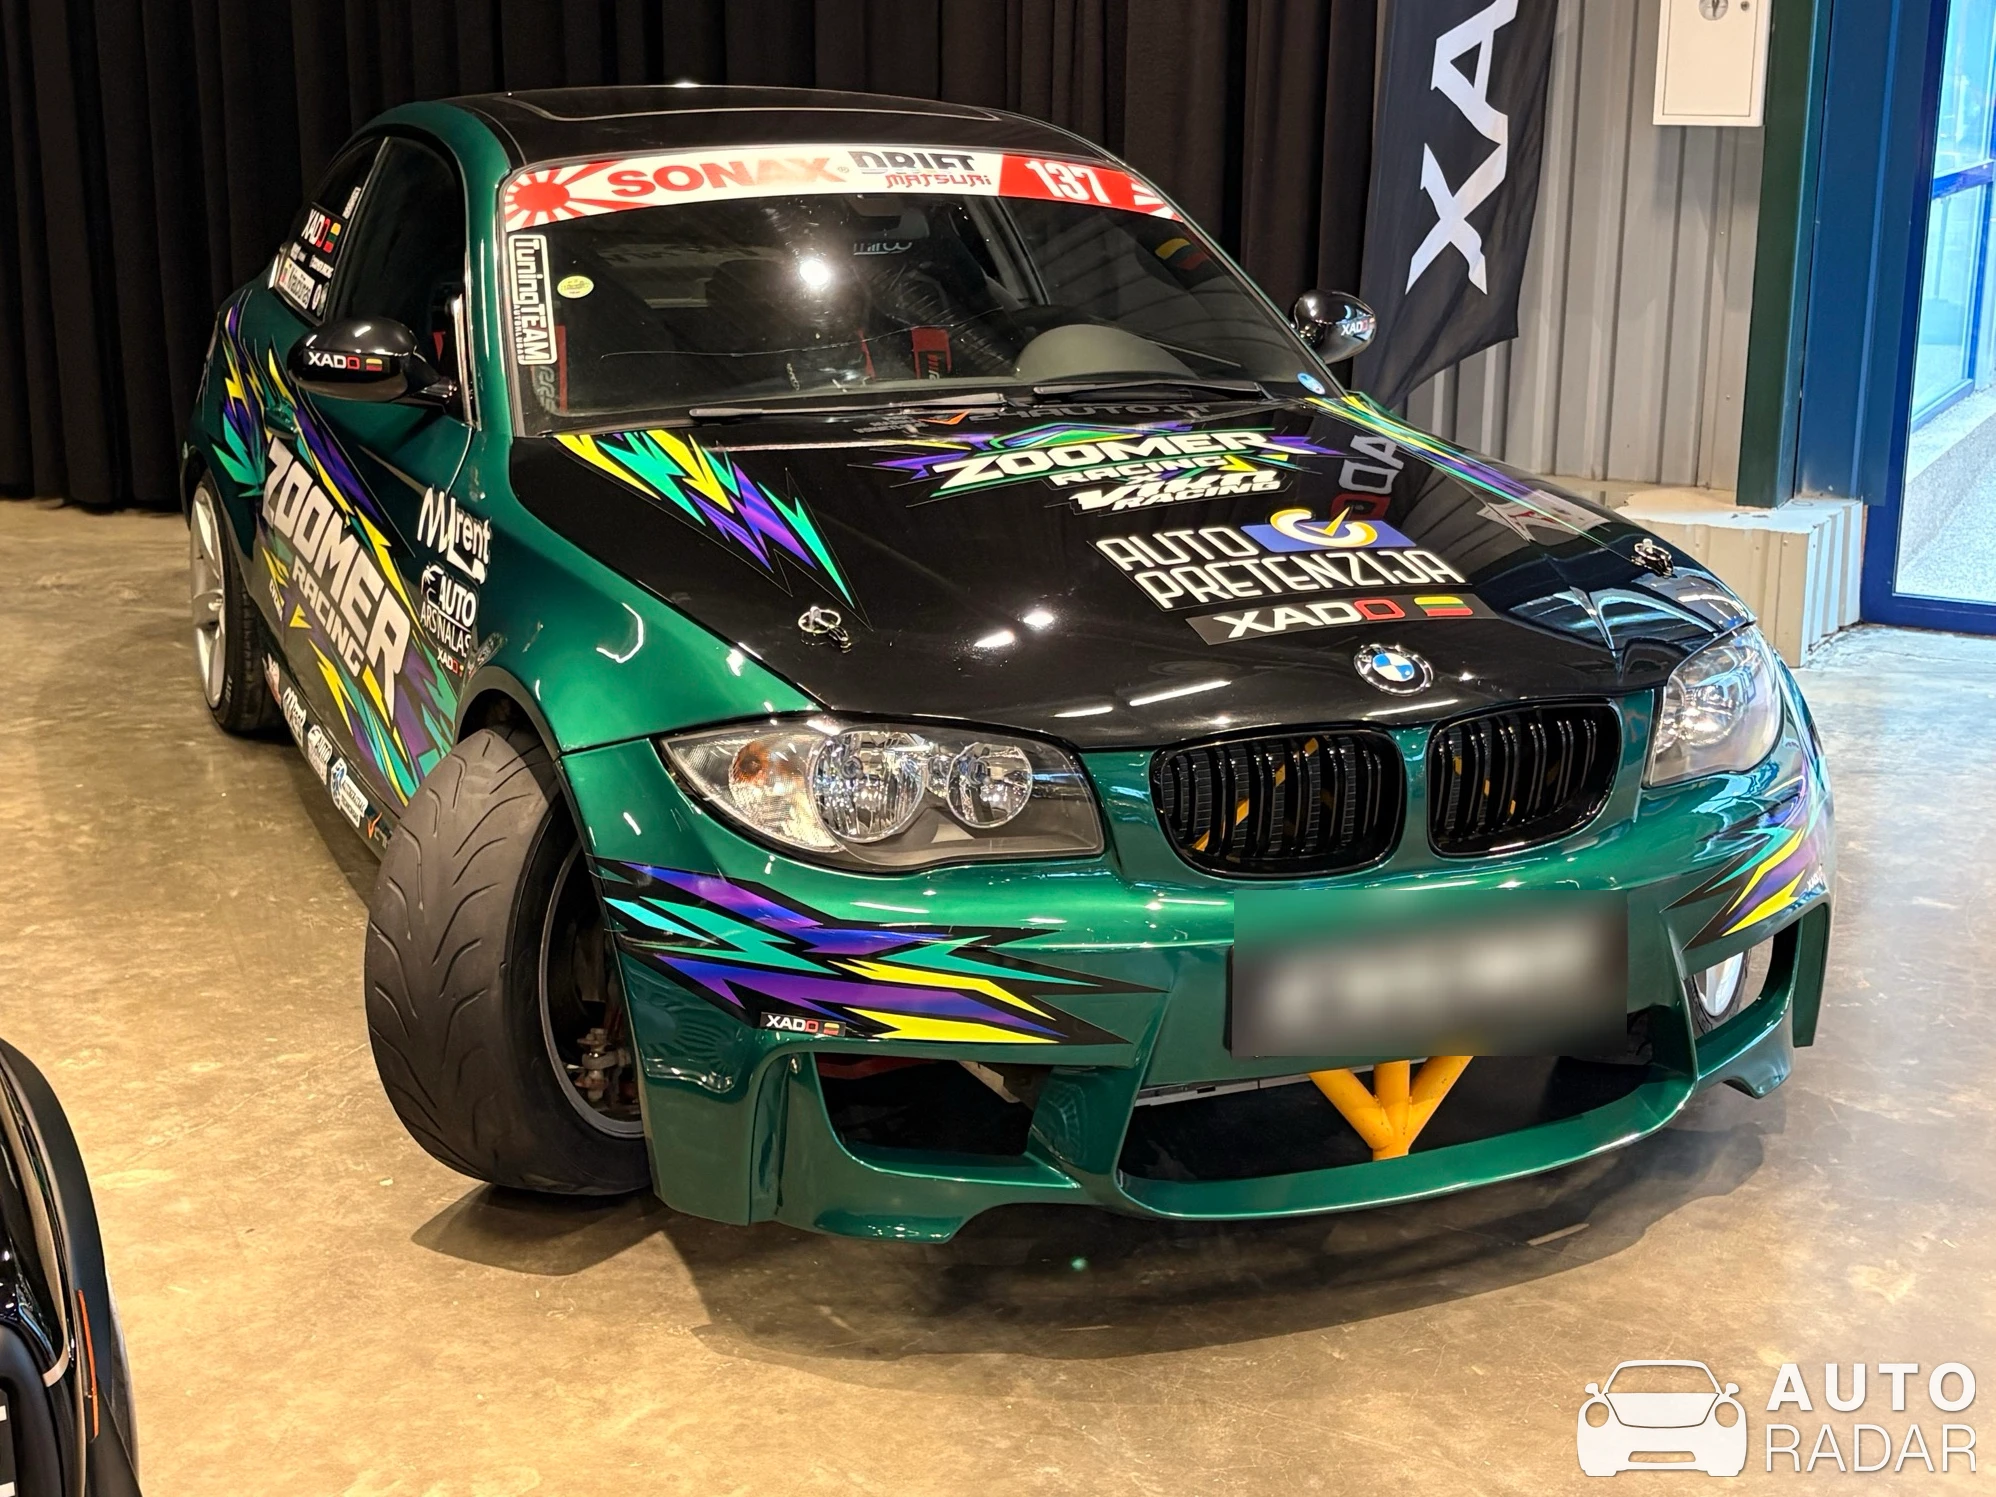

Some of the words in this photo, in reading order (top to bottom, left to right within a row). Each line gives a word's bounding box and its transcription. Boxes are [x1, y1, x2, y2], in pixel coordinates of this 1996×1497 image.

[607, 157, 848, 197] SONAX
[848, 150, 976, 175] DRIFT
[1024, 158, 1112, 205] 137
[301, 208, 331, 248] XADO
[1341, 319, 1369, 336] XADO
[308, 351, 360, 370] XADO
[933, 431, 1317, 490] ZOOMER
[1049, 455, 1229, 487] RACING
[1112, 480, 1281, 511] RACING
[1096, 527, 1260, 572] AUTO
[262, 436, 411, 721] ZOOMER
[1134, 550, 1467, 609] PRETENZIJA
[292, 554, 365, 678] RACING
[438, 575, 477, 629] AUTO
[1213, 598, 1406, 639] XADO
[437, 648, 459, 677] XADO
[766, 1014, 819, 1033] XADO
